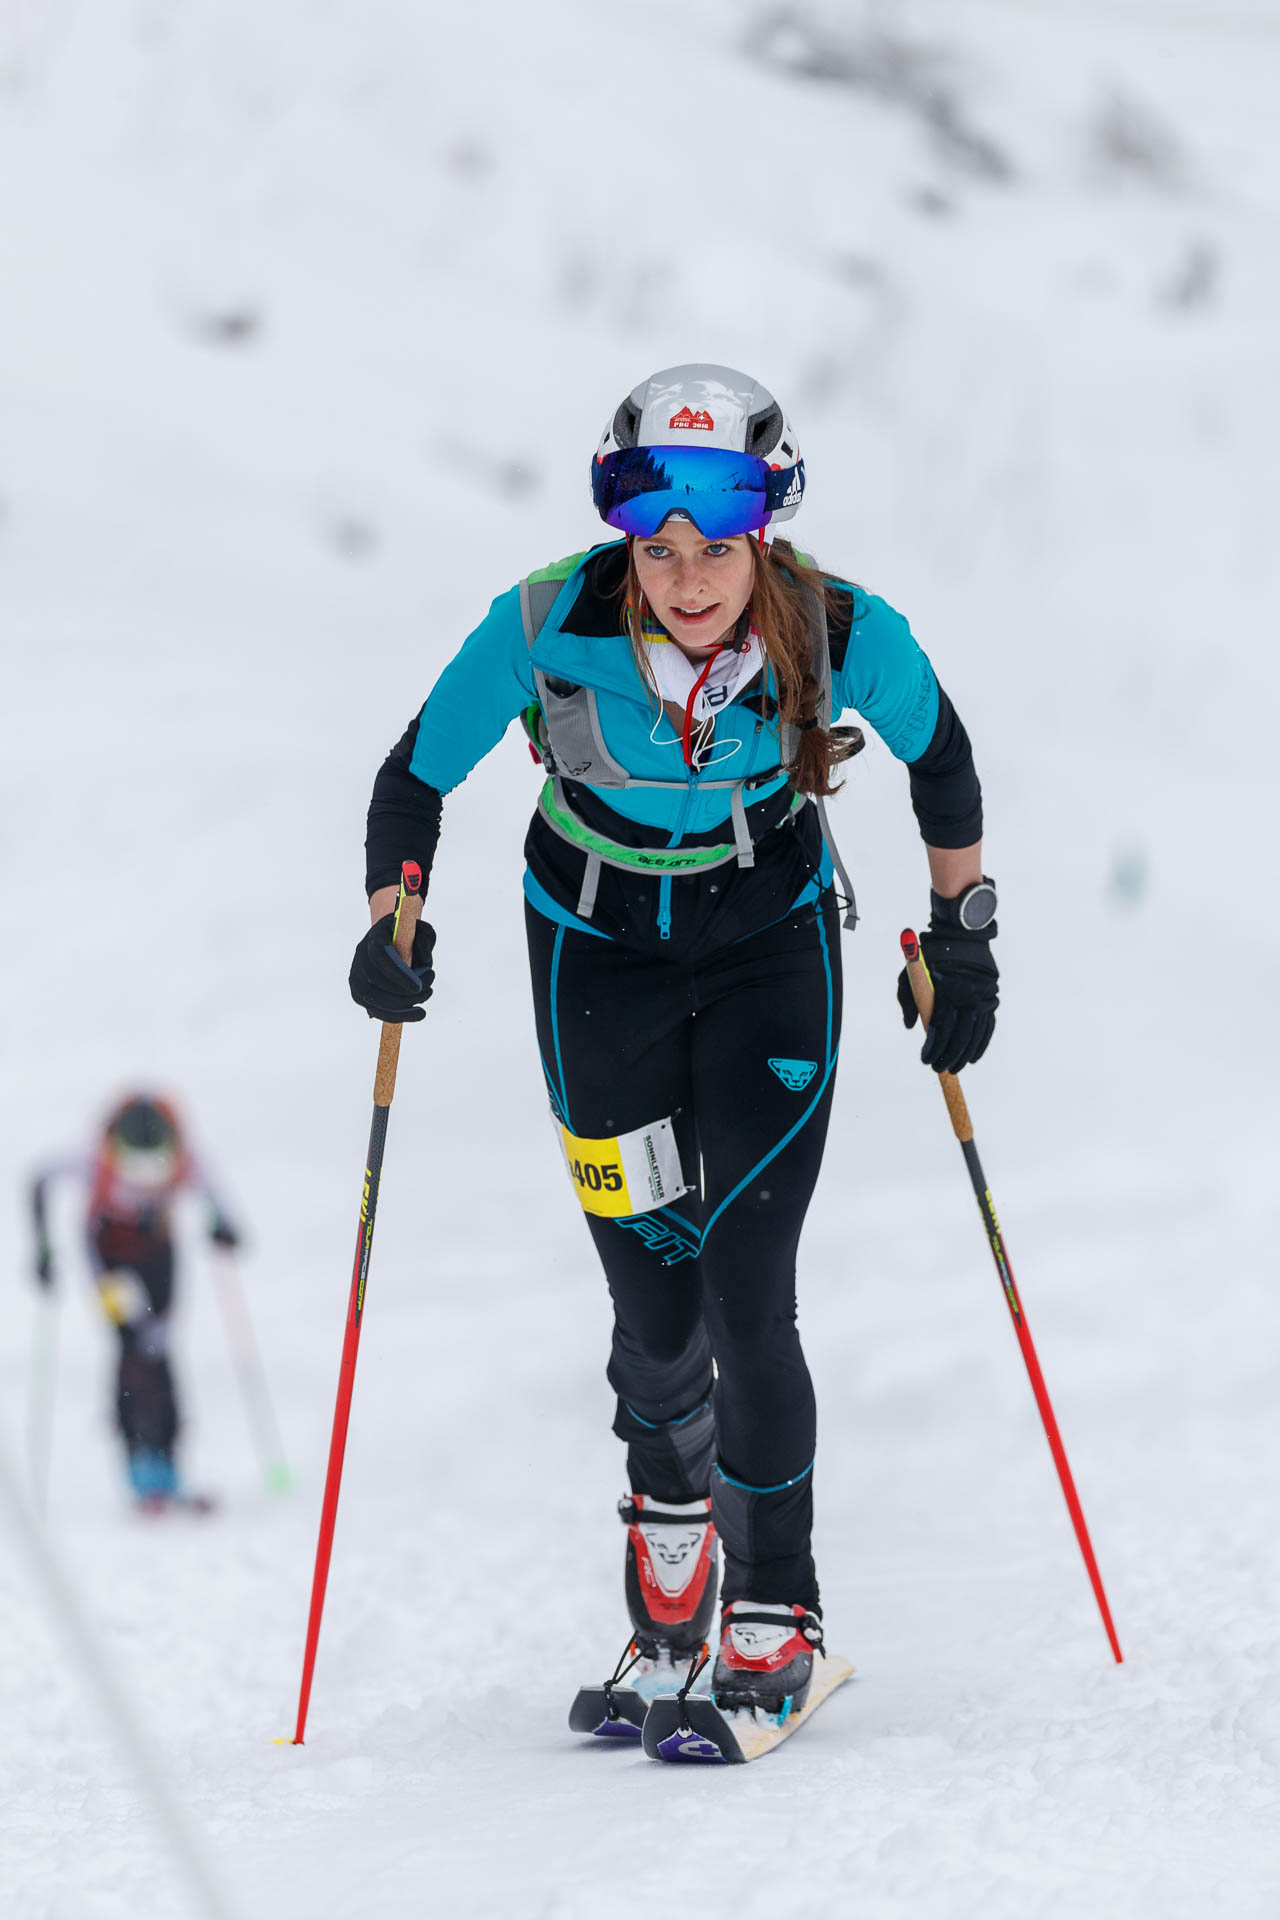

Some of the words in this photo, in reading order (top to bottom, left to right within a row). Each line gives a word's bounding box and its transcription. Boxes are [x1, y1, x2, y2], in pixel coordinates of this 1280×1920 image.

[782, 491, 802, 507] adidas
[568, 1158, 623, 1192] 405
[645, 1134, 665, 1200] SONNLEITNER
